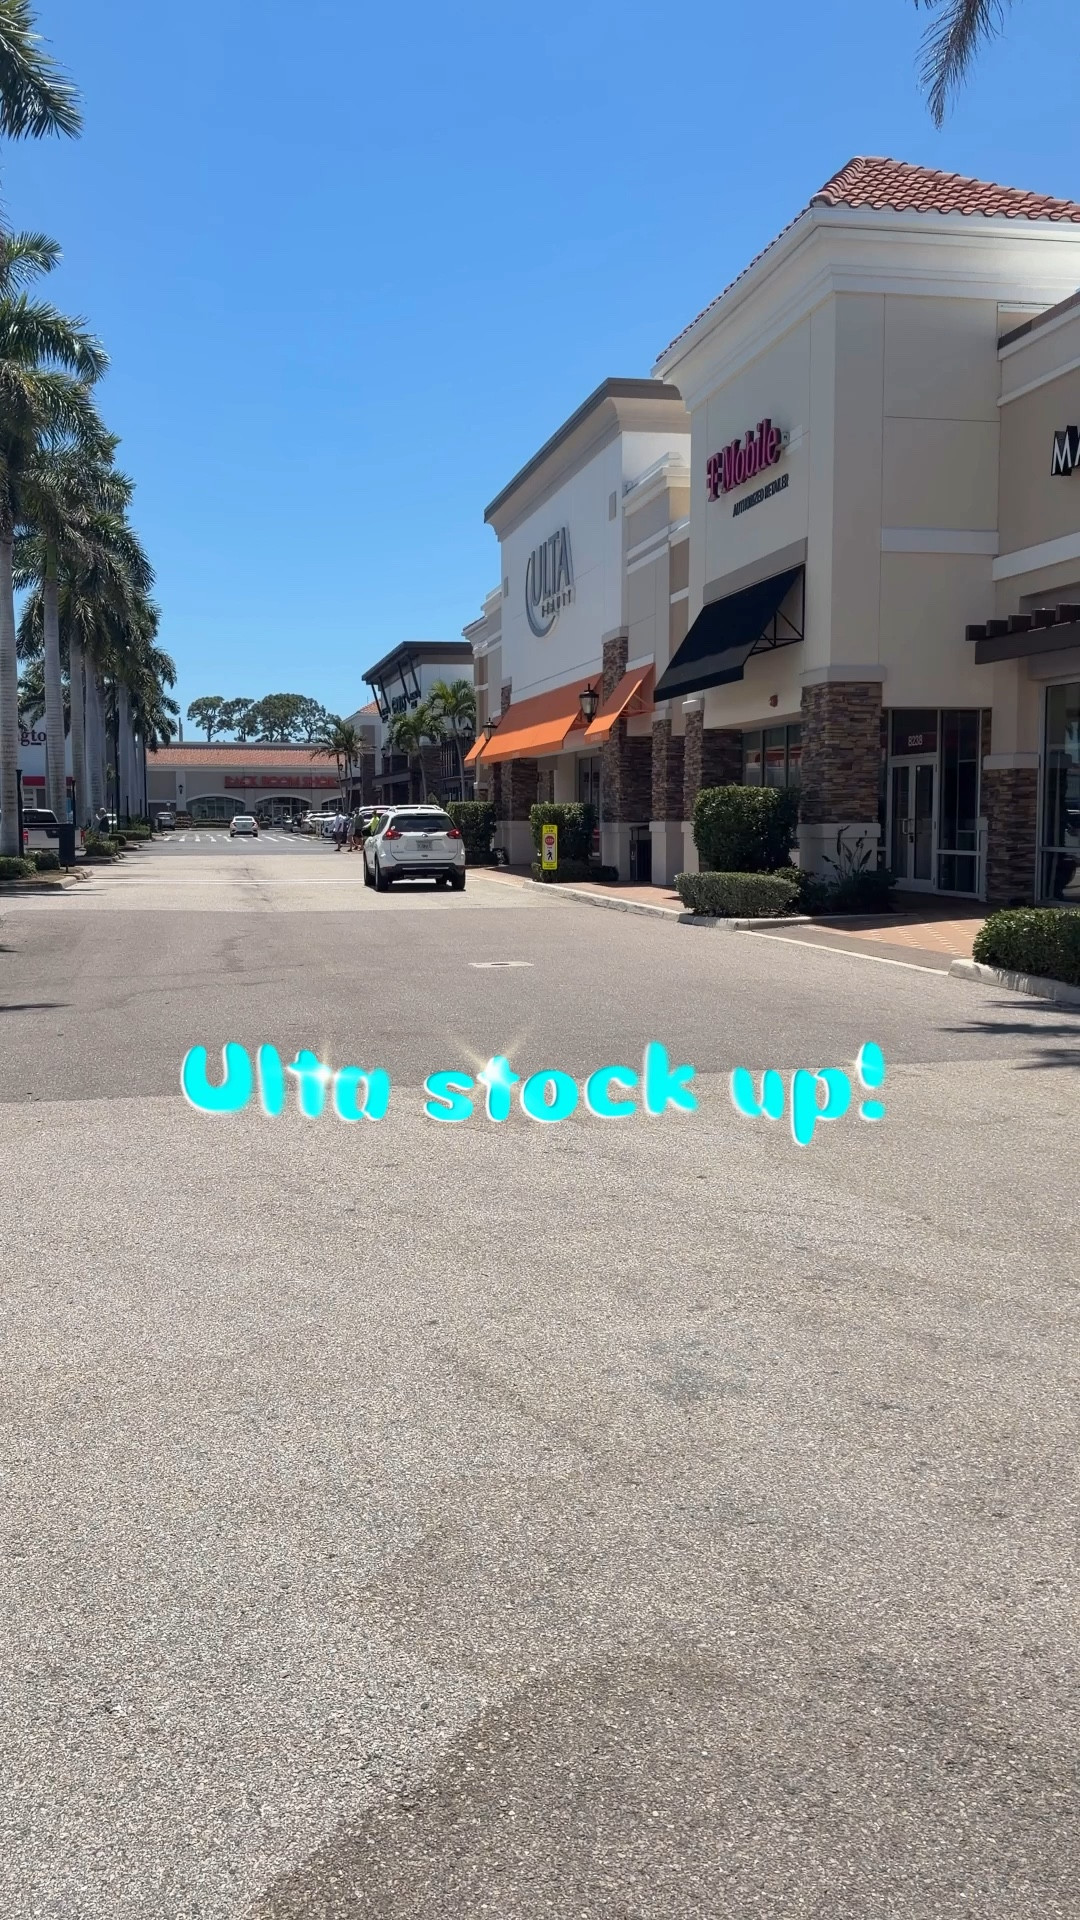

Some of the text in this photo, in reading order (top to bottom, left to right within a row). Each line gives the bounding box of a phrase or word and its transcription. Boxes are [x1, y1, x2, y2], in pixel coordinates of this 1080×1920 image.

[707, 418, 781, 502] T-Mobile
[732, 473, 789, 518] AUTHORIZED RETAILER
[908, 734, 923, 747] 8238
